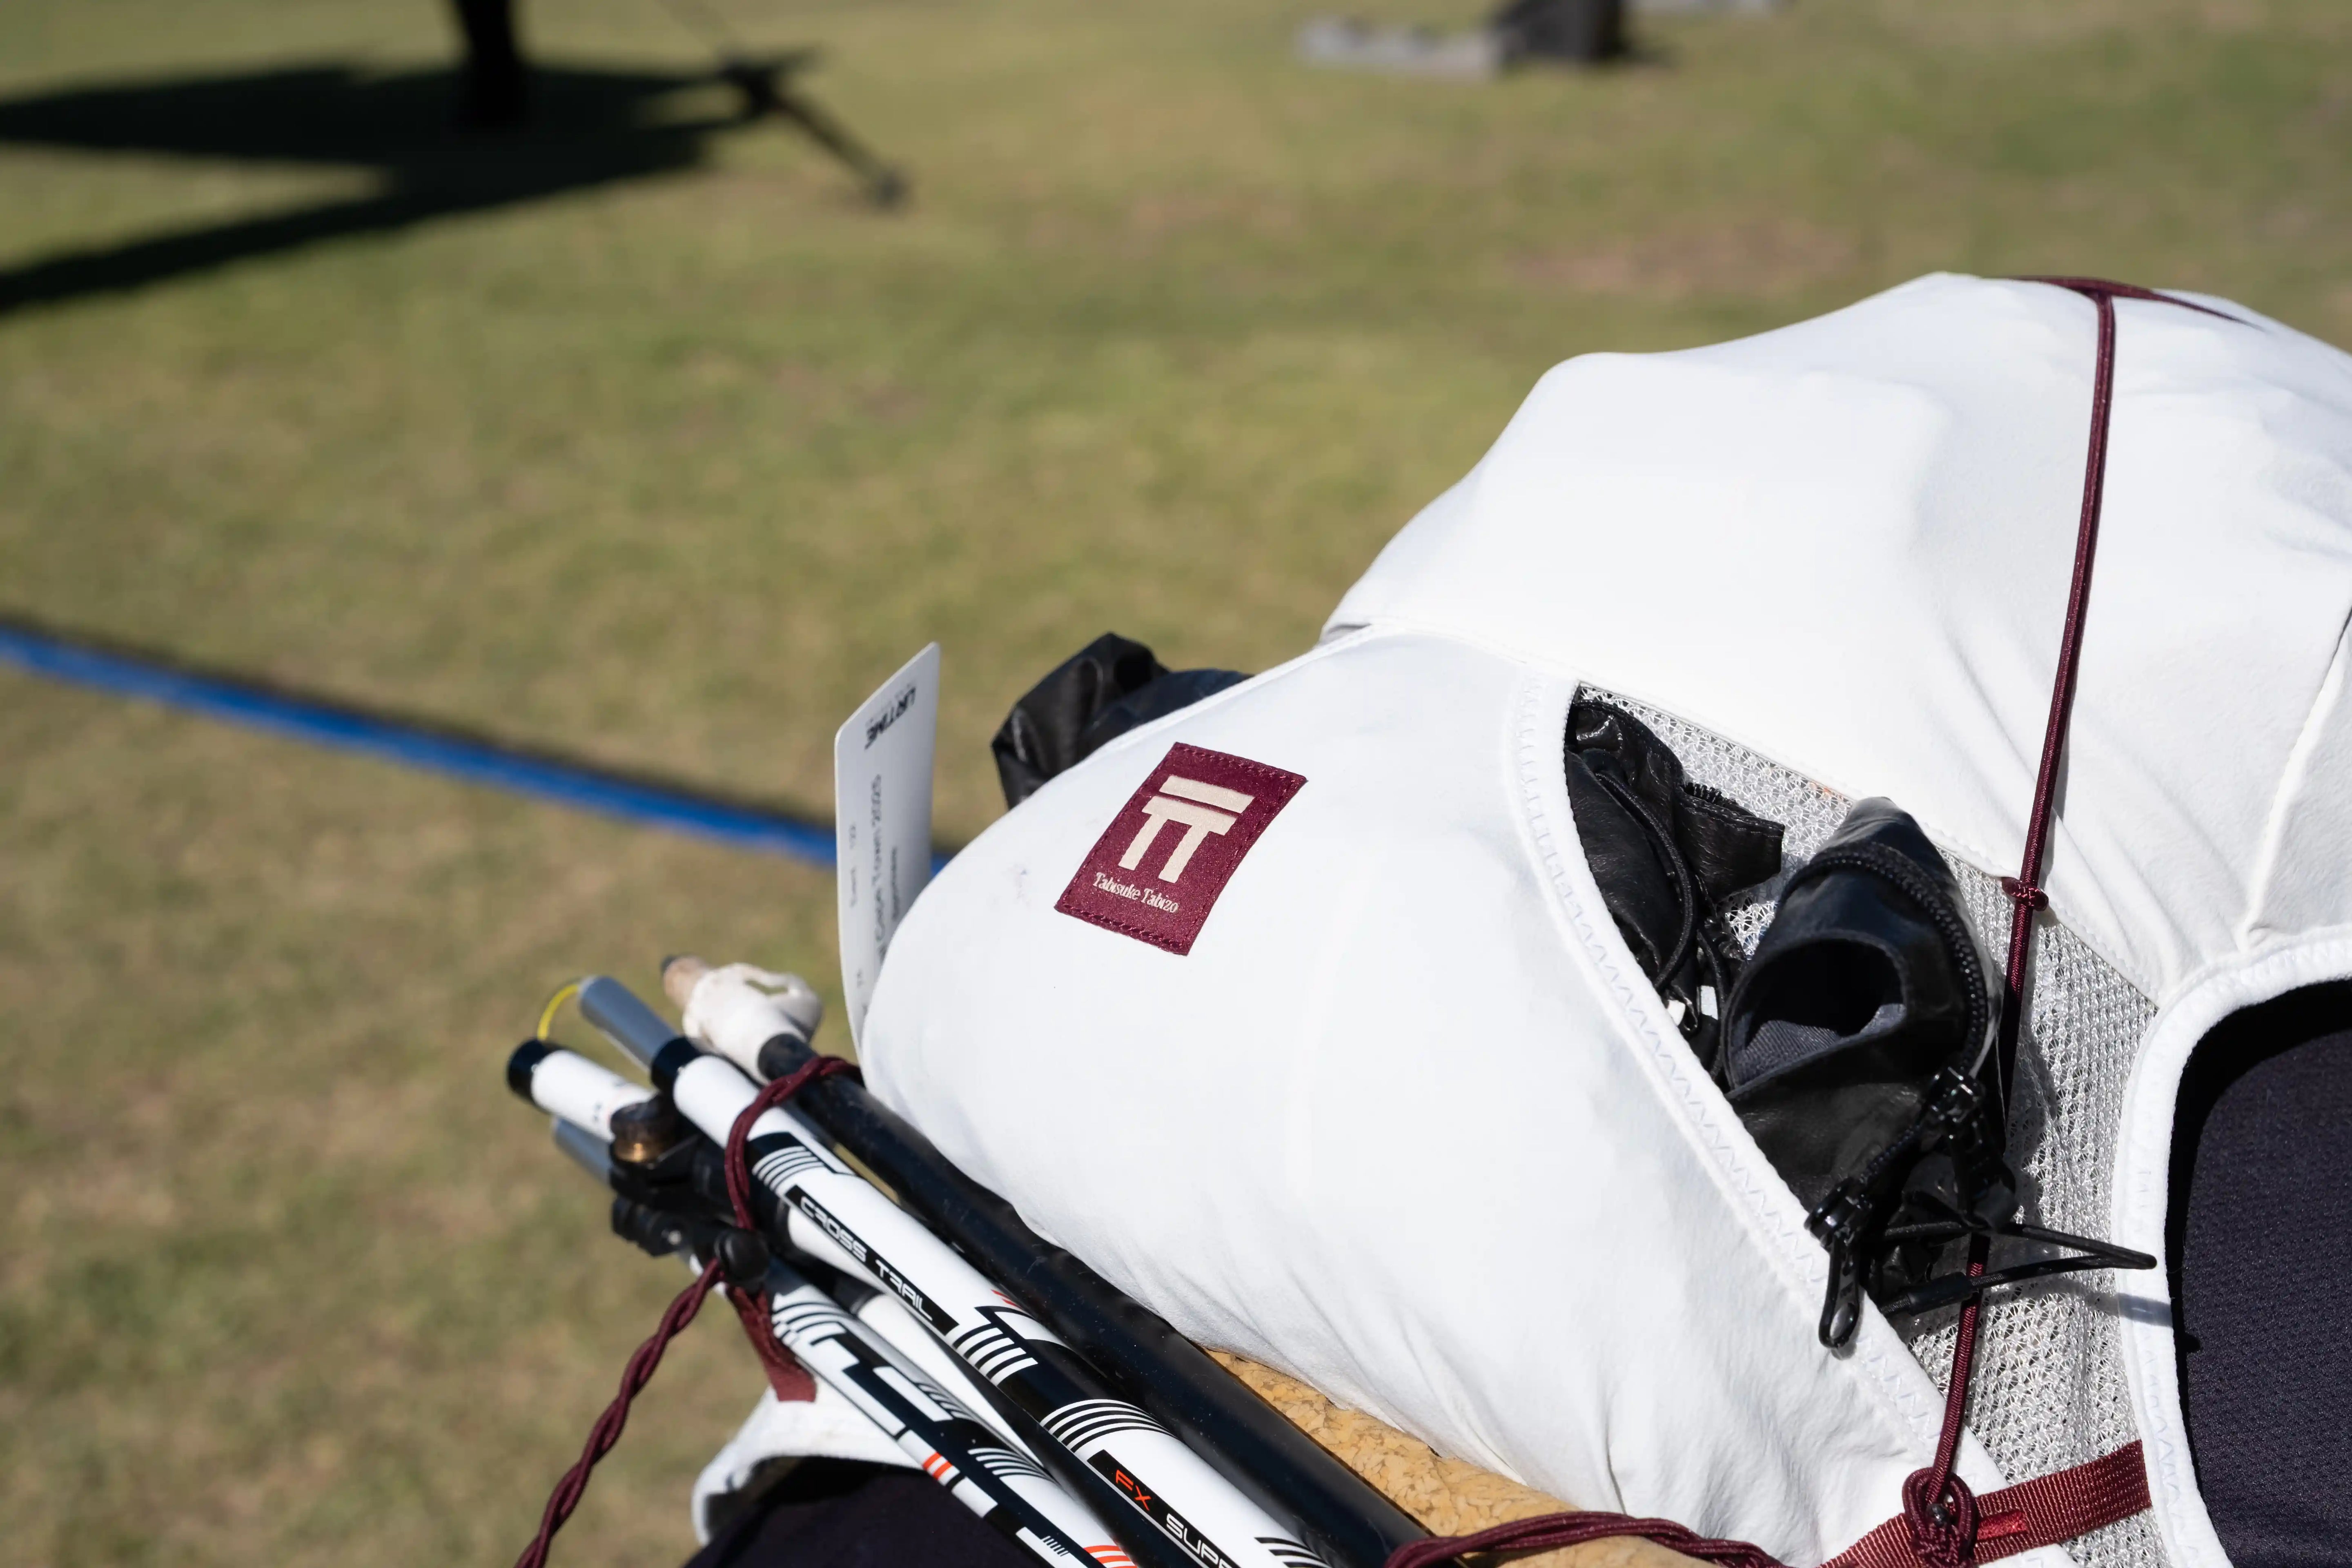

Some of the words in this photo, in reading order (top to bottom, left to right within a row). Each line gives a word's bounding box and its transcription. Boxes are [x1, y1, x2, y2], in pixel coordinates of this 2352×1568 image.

[1093, 872, 1141, 900] Tabisuke
[1140, 888, 1179, 913] Tabizo
[800, 1196, 867, 1262] CROSS
[875, 1259, 933, 1321] TRAIL
[1116, 1470, 1152, 1511] FX
